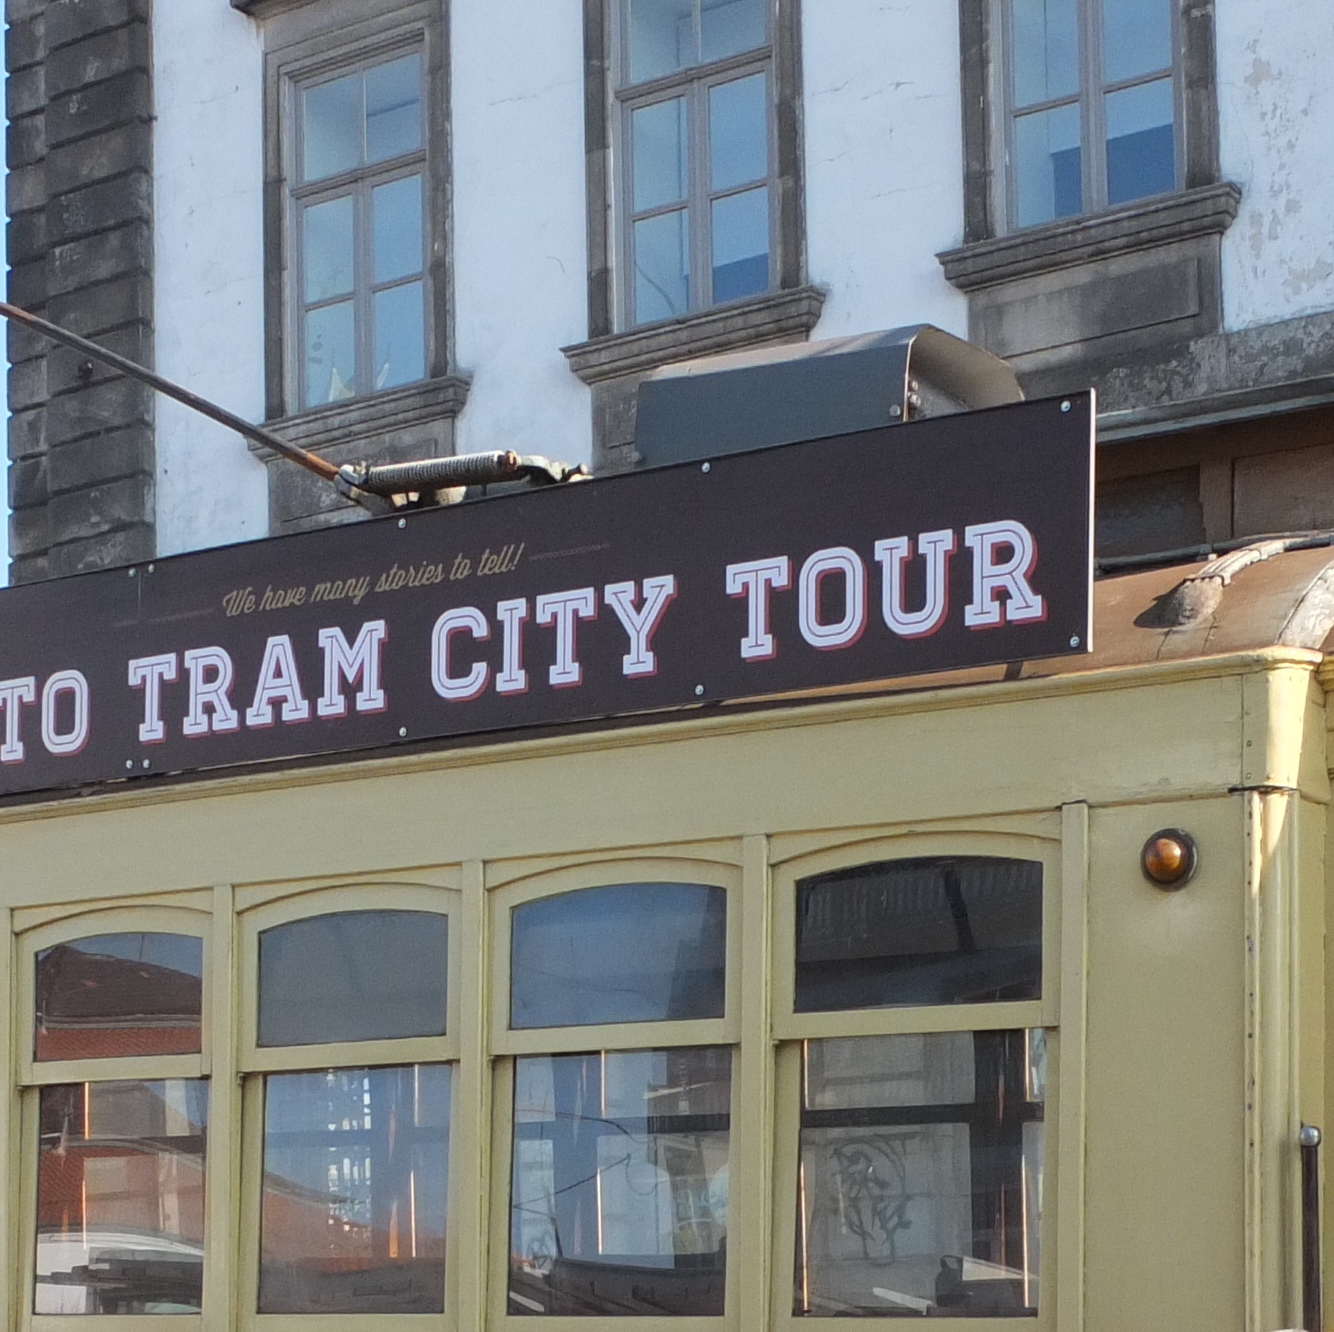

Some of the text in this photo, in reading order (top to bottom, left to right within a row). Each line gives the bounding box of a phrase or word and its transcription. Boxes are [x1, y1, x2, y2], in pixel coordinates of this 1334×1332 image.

[127, 619, 387, 744] TRAM
[430, 573, 676, 704] CITY
[725, 519, 1049, 661] TOUR
[222, 542, 525, 617] We have many stories to tell!
